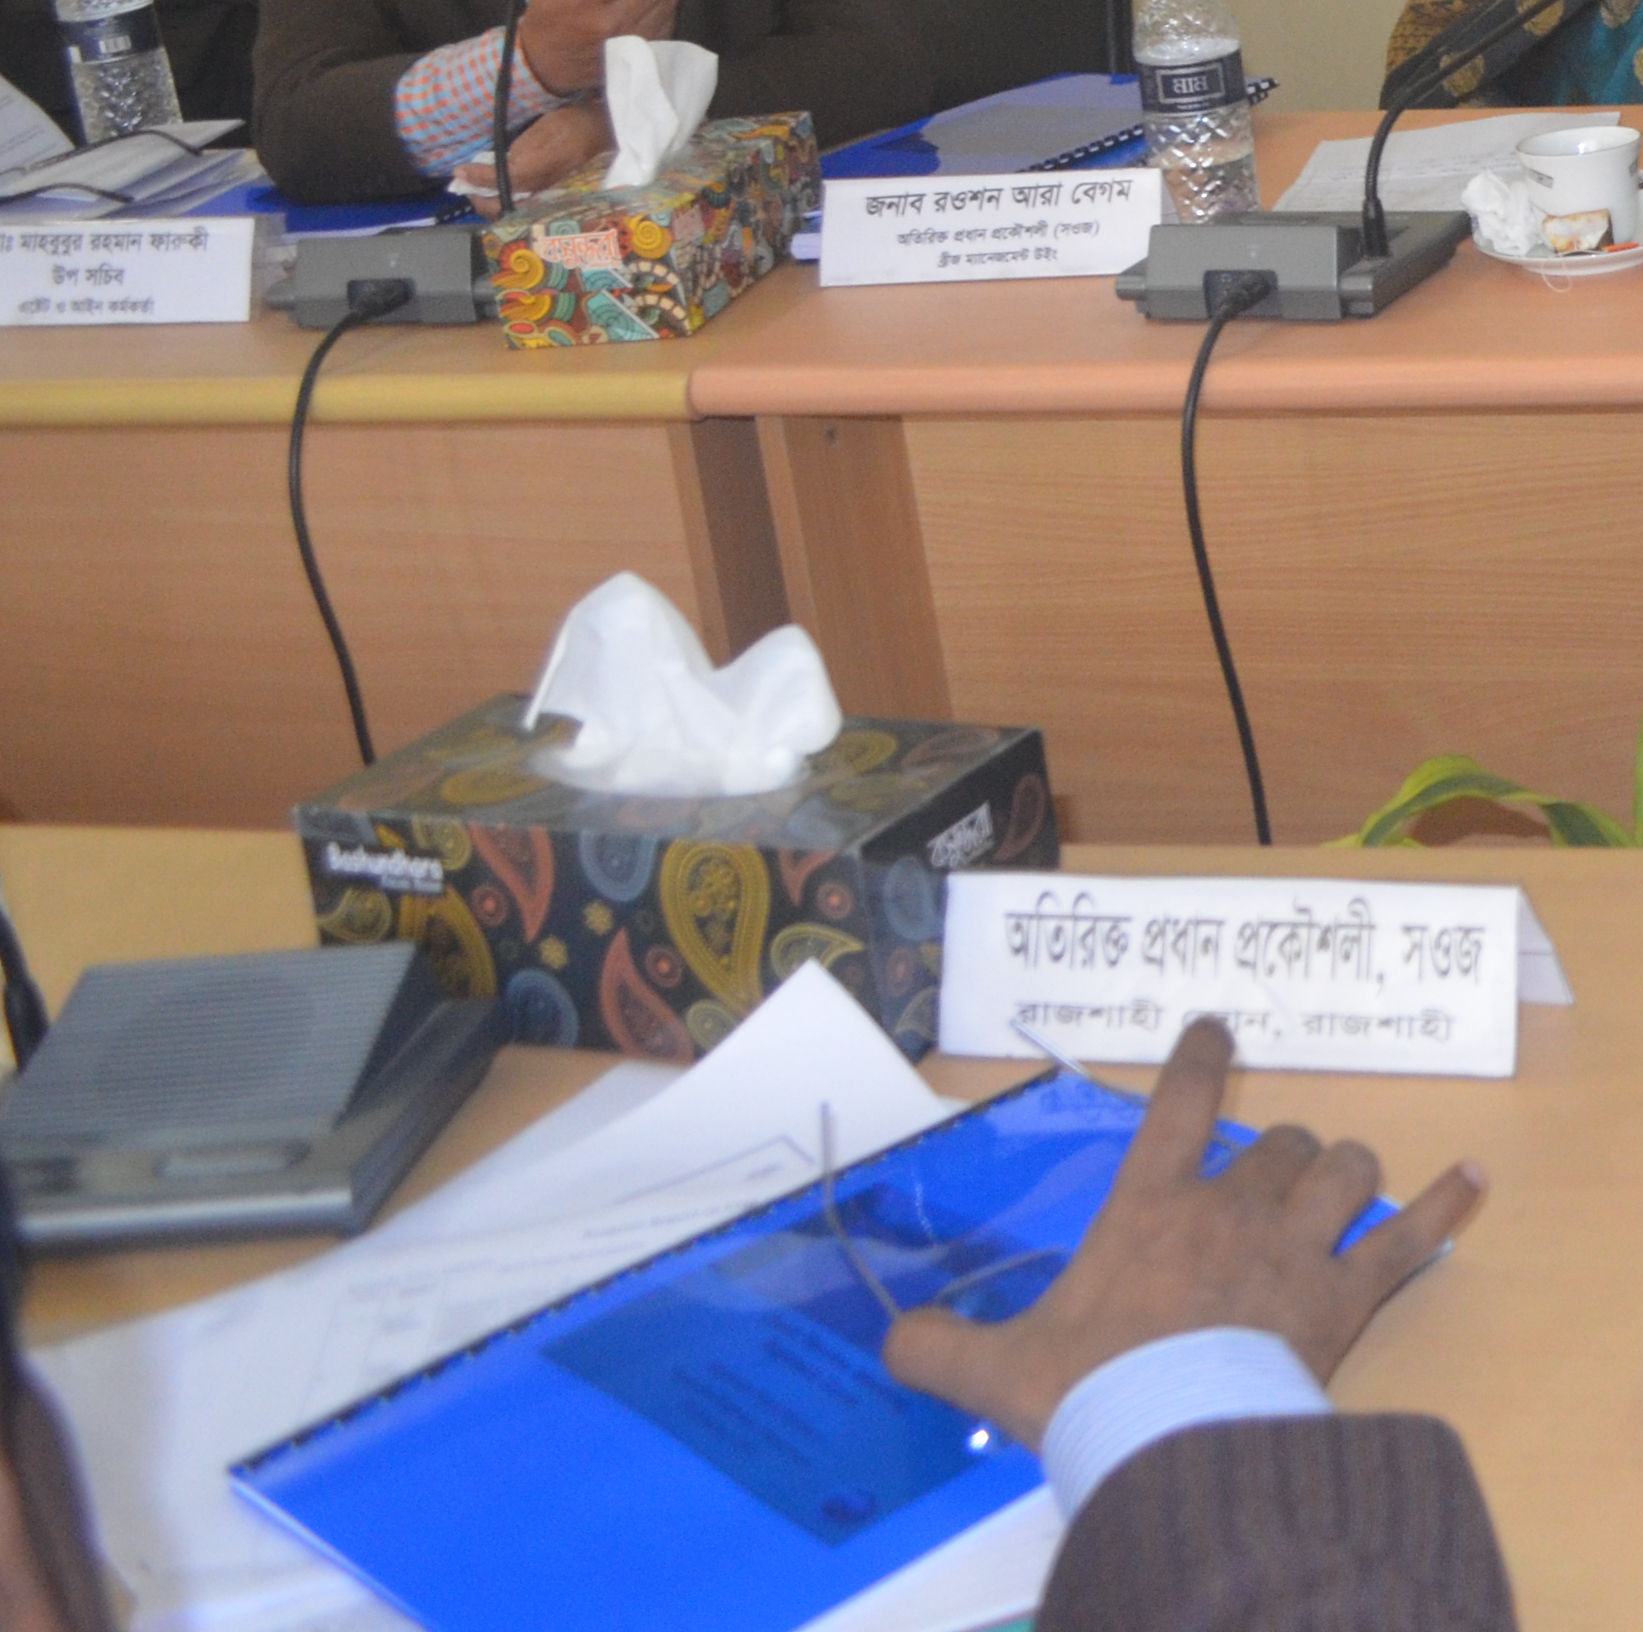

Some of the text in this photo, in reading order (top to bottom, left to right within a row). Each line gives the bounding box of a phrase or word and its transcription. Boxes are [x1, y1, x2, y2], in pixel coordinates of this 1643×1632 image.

[865, 178, 1134, 217] জনাব রওশন আরা বেগম
[90, 232, 143, 254] রহমান
[52, 262, 125, 286] উপ সচিব
[1004, 891, 1132, 971] অতিরিক্ত
[1141, 911, 1225, 977] প্রধান
[1401, 923, 1486, 985] সওজ
[1015, 998, 1165, 1032] রাজশাহী
[1299, 1008, 1456, 1045] রাজশাহী
